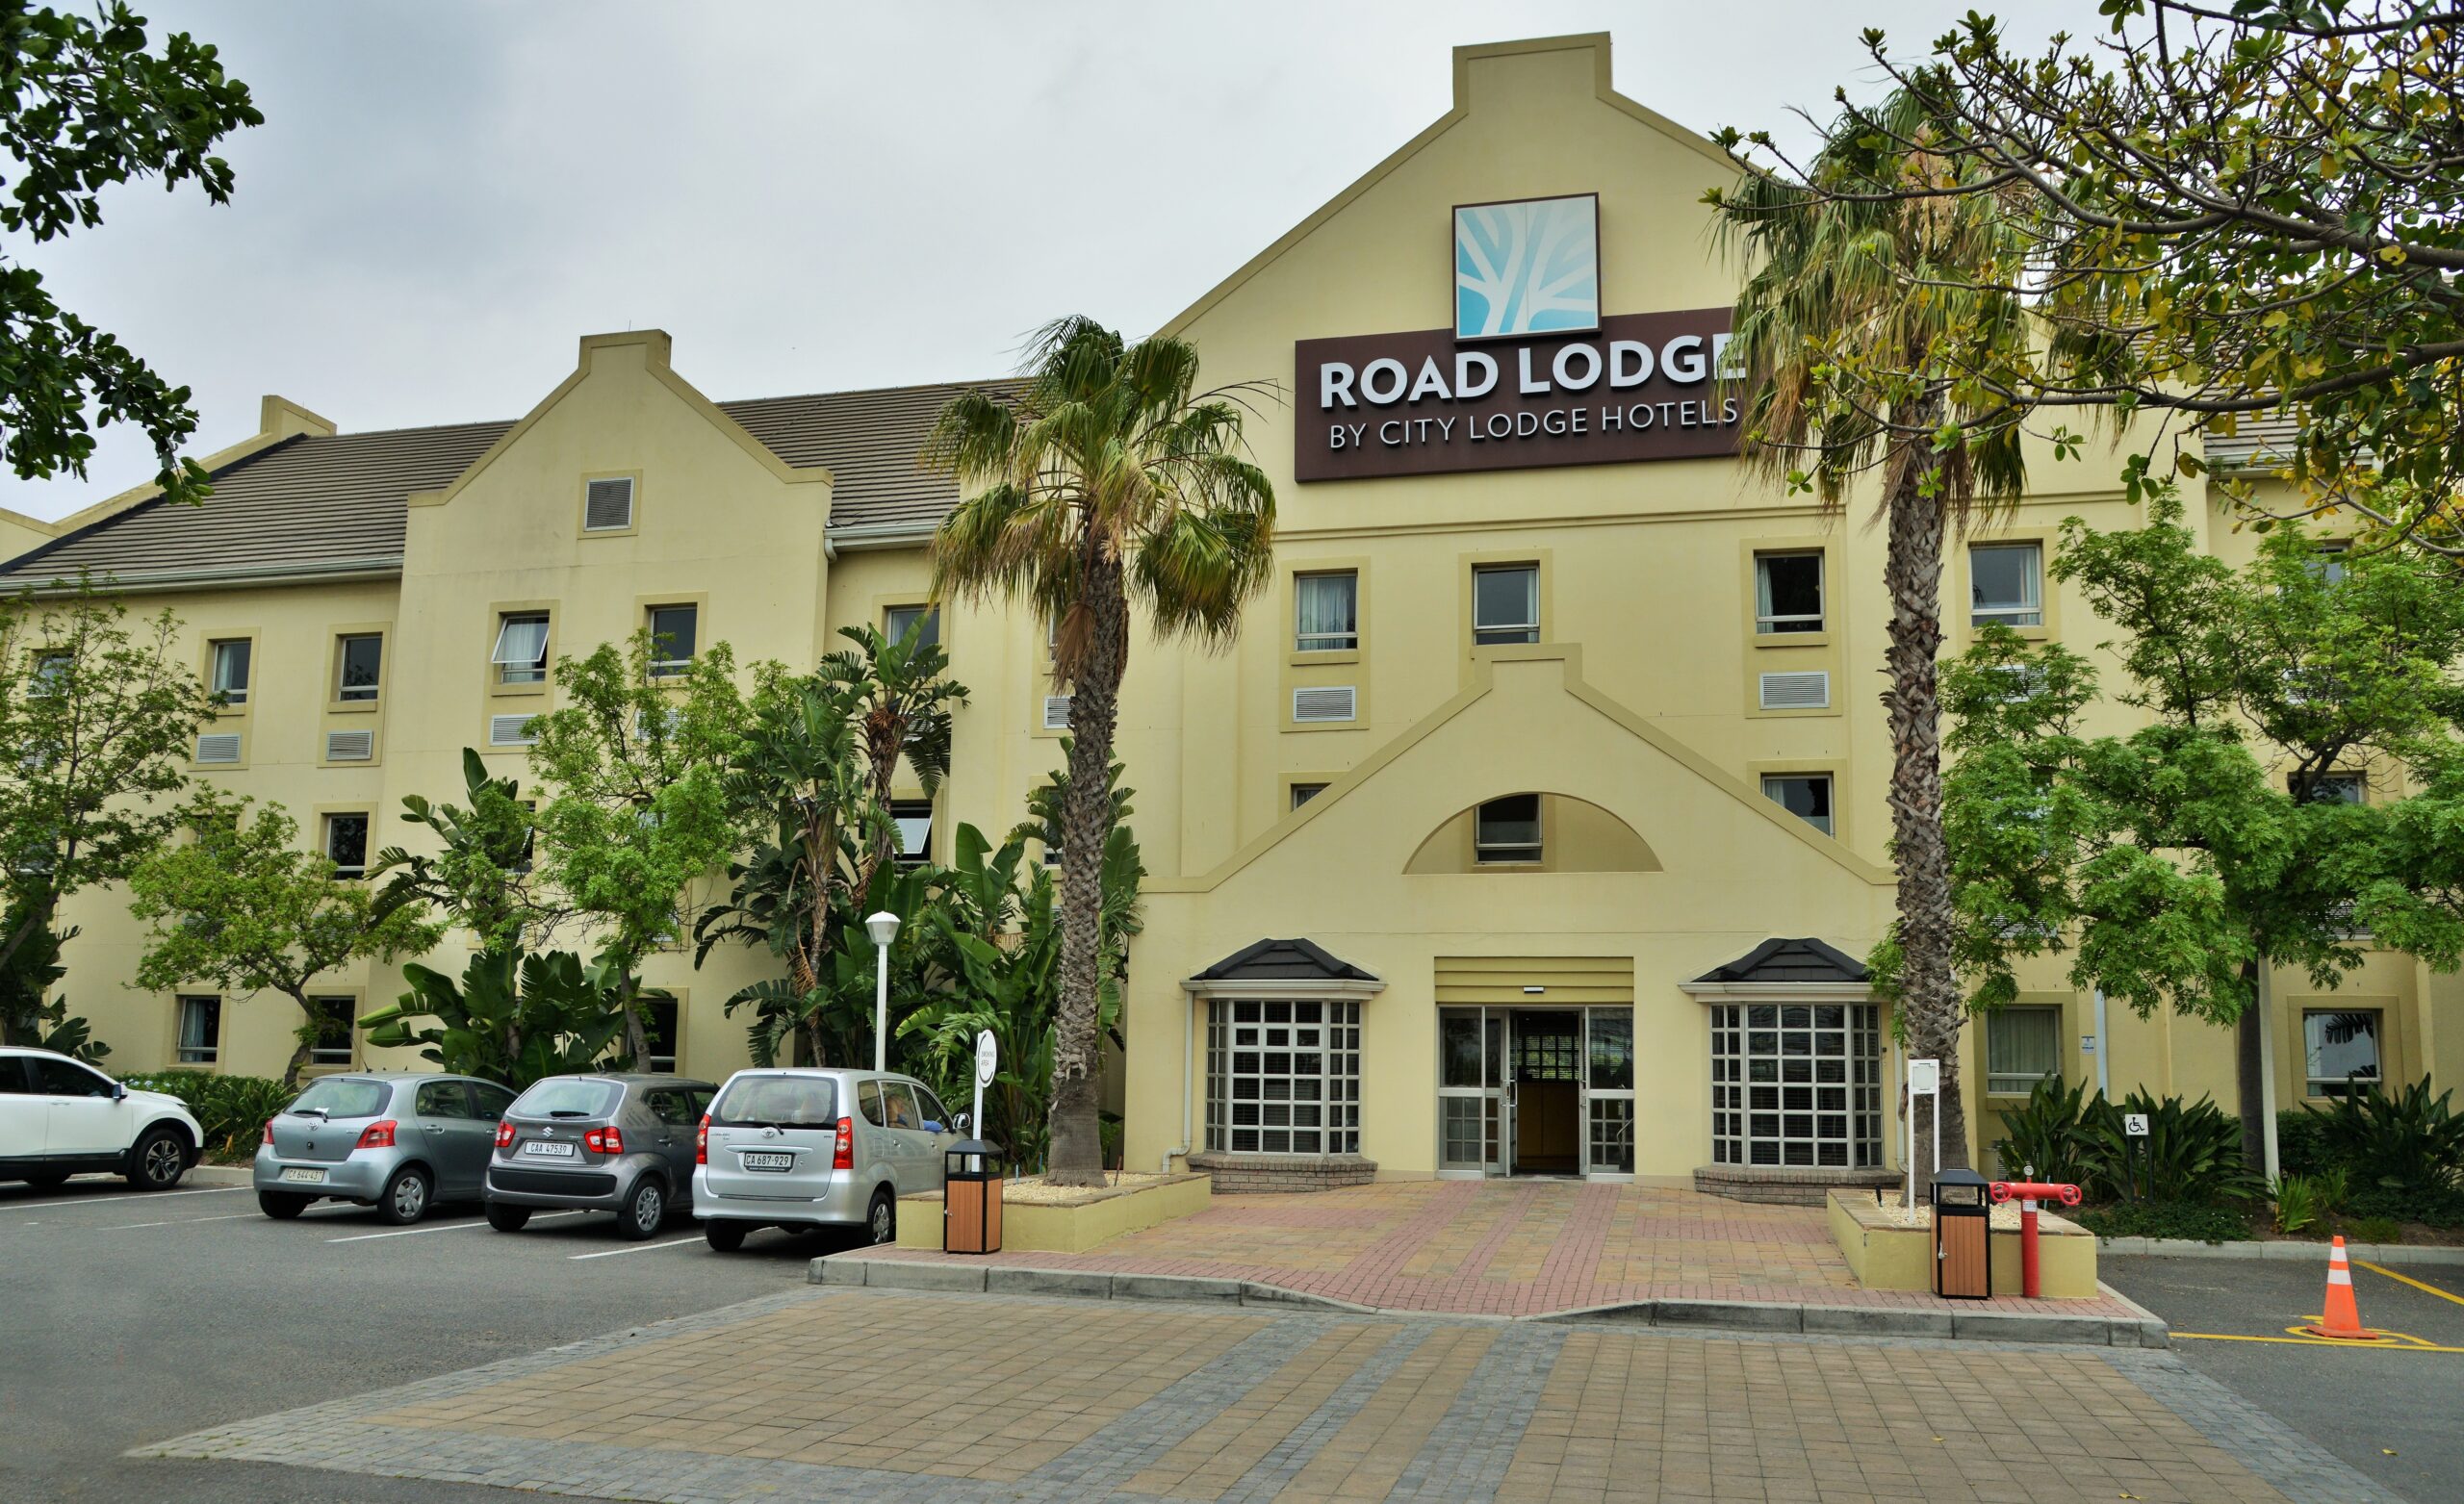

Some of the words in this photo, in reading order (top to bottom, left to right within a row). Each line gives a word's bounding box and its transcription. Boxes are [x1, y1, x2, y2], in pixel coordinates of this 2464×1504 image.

[1321, 351, 1500, 408] ROAD
[1519, 333, 1747, 395] LODGE
[1330, 422, 1367, 448] BY
[1379, 417, 1456, 446] CITY
[1470, 408, 1587, 439] LODGE
[1602, 397, 1737, 431] HOTELS
[530, 1143, 543, 1153] CAA
[546, 1144, 567, 1154] 47539
[746, 1155, 756, 1164] CA
[757, 1155, 789, 1166] 687-929
